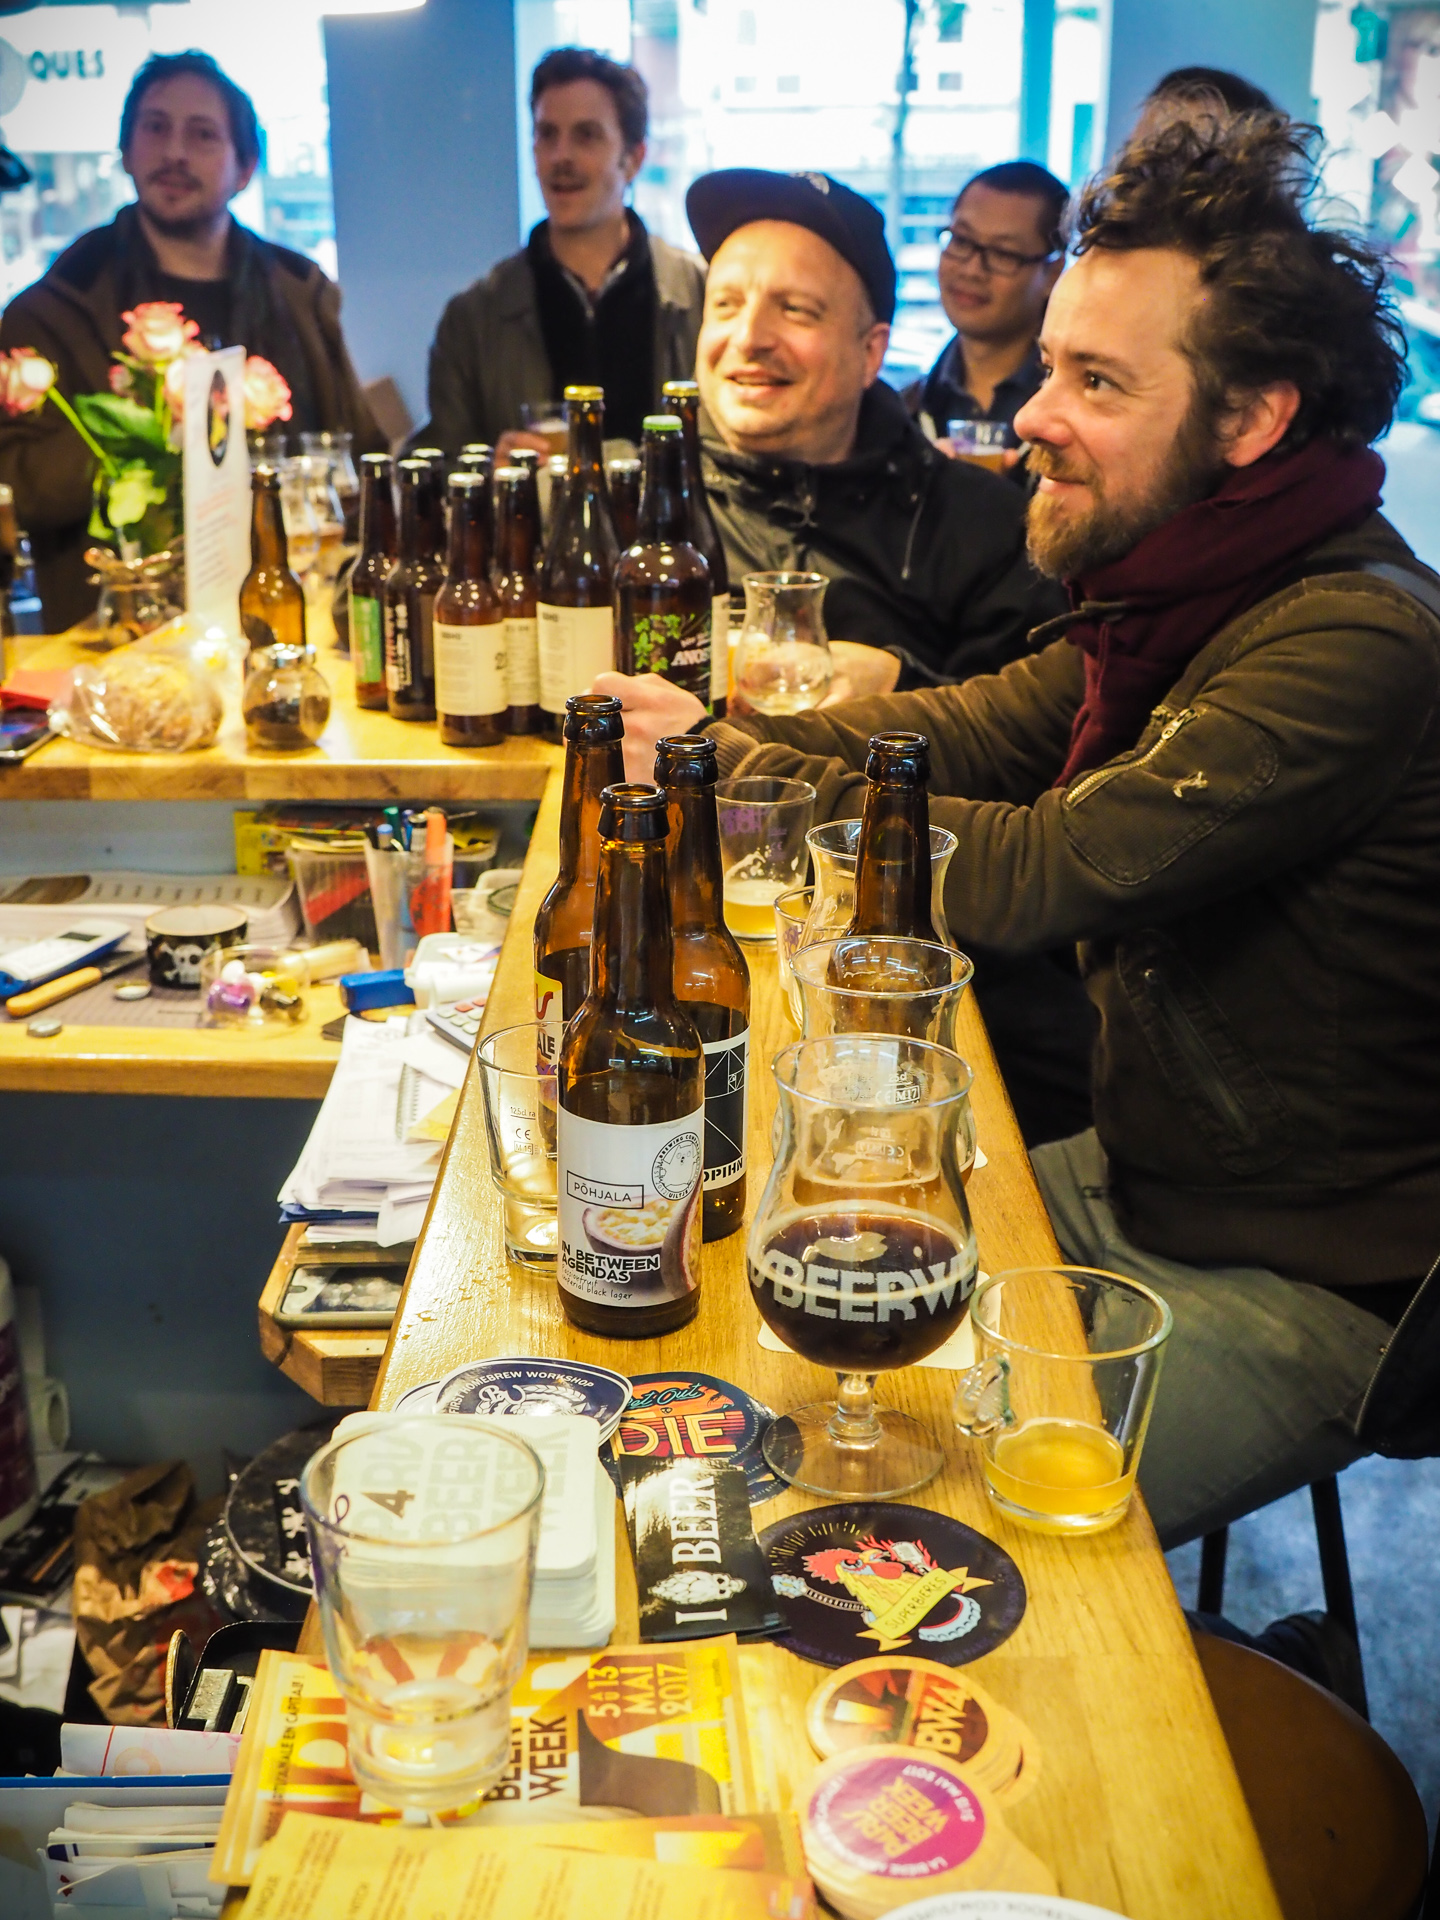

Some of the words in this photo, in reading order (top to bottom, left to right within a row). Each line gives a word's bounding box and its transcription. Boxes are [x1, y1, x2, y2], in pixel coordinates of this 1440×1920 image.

[574, 1182, 632, 1202] PÕHJALA
[562, 1253, 631, 1283] AGENDAS
[575, 1249, 660, 1270] BETWEEN
[586, 1283, 608, 1298] black
[610, 1286, 634, 1301] lager
[449, 1395, 465, 1414] FIRST
[463, 1371, 523, 1395] HOMEBREW
[525, 1371, 595, 1388] WORKSHOP
[657, 1383, 703, 1406] Out
[611, 1412, 738, 1462] DIE
[669, 1475, 722, 1565] BEER
[675, 1608, 728, 1625] I
[619, 1665, 657, 1715] MAI
[656, 1662, 693, 1717] 2017
[528, 1714, 568, 1801] WEEK
